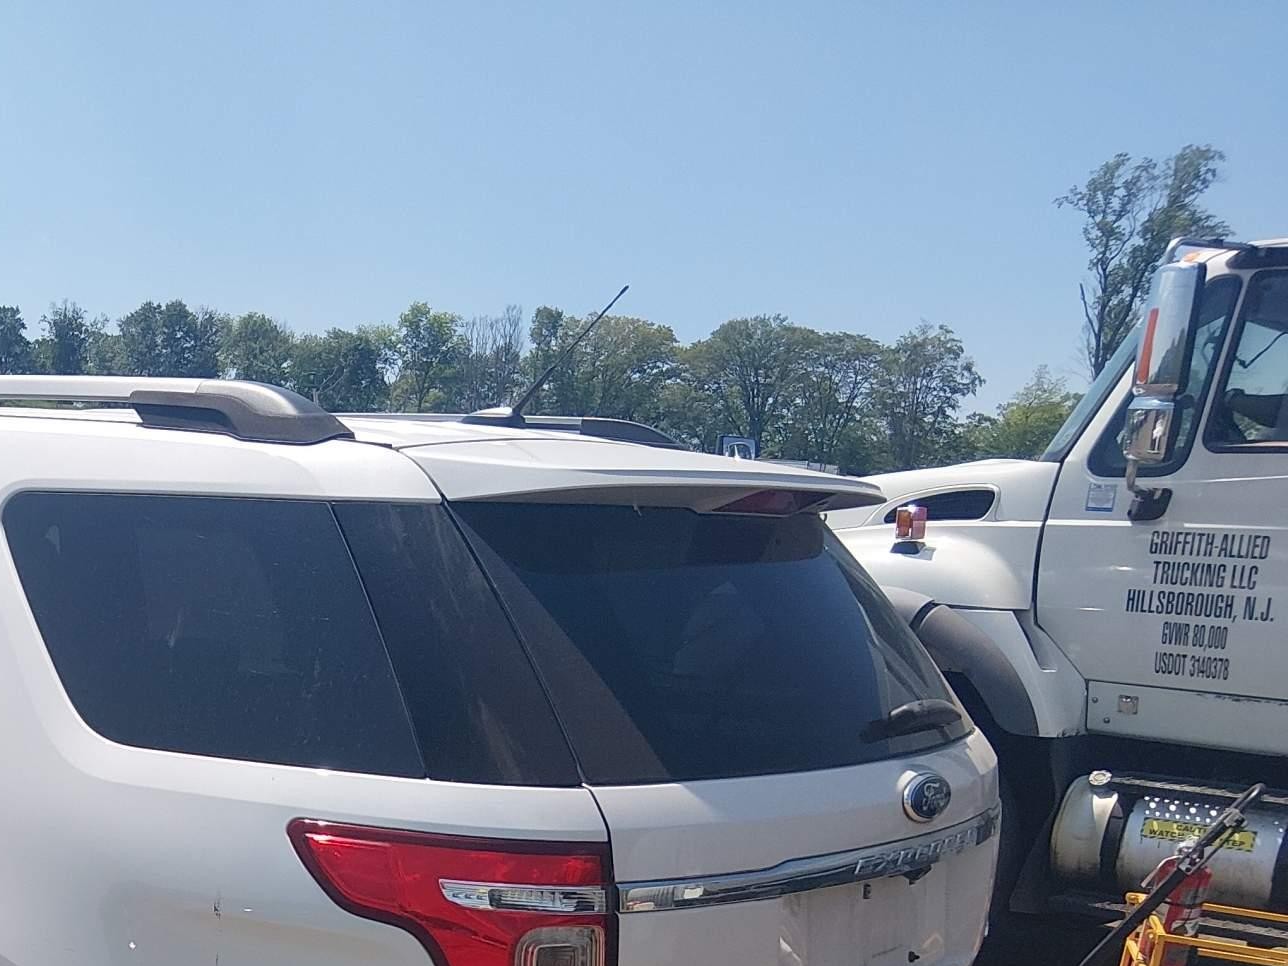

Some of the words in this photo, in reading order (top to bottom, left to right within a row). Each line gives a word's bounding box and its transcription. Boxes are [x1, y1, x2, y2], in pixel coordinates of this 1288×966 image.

[1149, 530, 1271, 560] GRIFFITH-ALLIED
[1153, 560, 1226, 588] TRUCKING
[1230, 563, 1259, 590] LLC
[1125, 588, 1238, 623] HILLSBOROUGH,
[1242, 595, 1274, 622] N.J.
[1161, 621, 1190, 647] GVWR
[1191, 625, 1229, 651] 80,000
[1154, 651, 1188, 675] USDOT
[1189, 655, 1230, 680] 3140378
